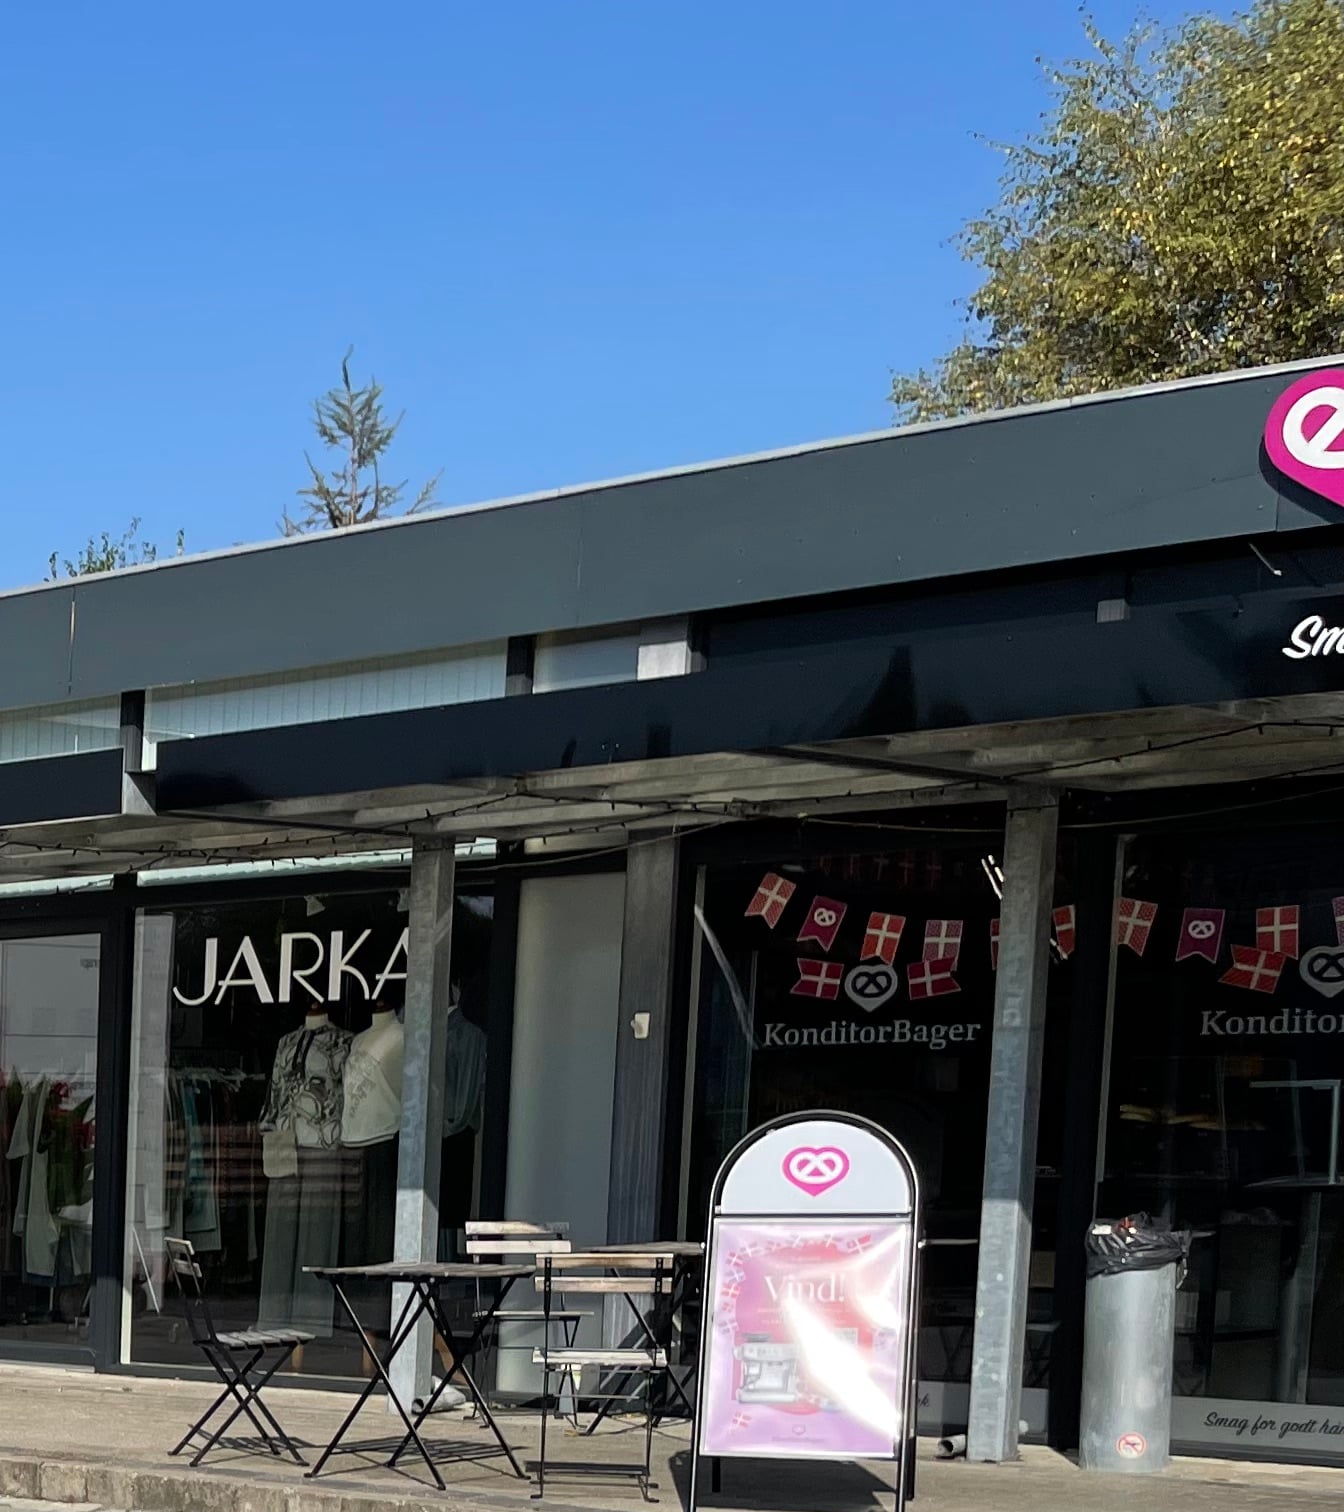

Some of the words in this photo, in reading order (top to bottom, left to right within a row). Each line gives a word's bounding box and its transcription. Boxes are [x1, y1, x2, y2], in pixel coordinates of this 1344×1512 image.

[173, 926, 410, 1006] JARKA
[763, 1019, 981, 1050] KonditorBager
[764, 1272, 846, 1302] Vind!
[1203, 1411, 1249, 1436] Smag
[1250, 1414, 1276, 1436] for
[1278, 1419, 1317, 1439] godt
